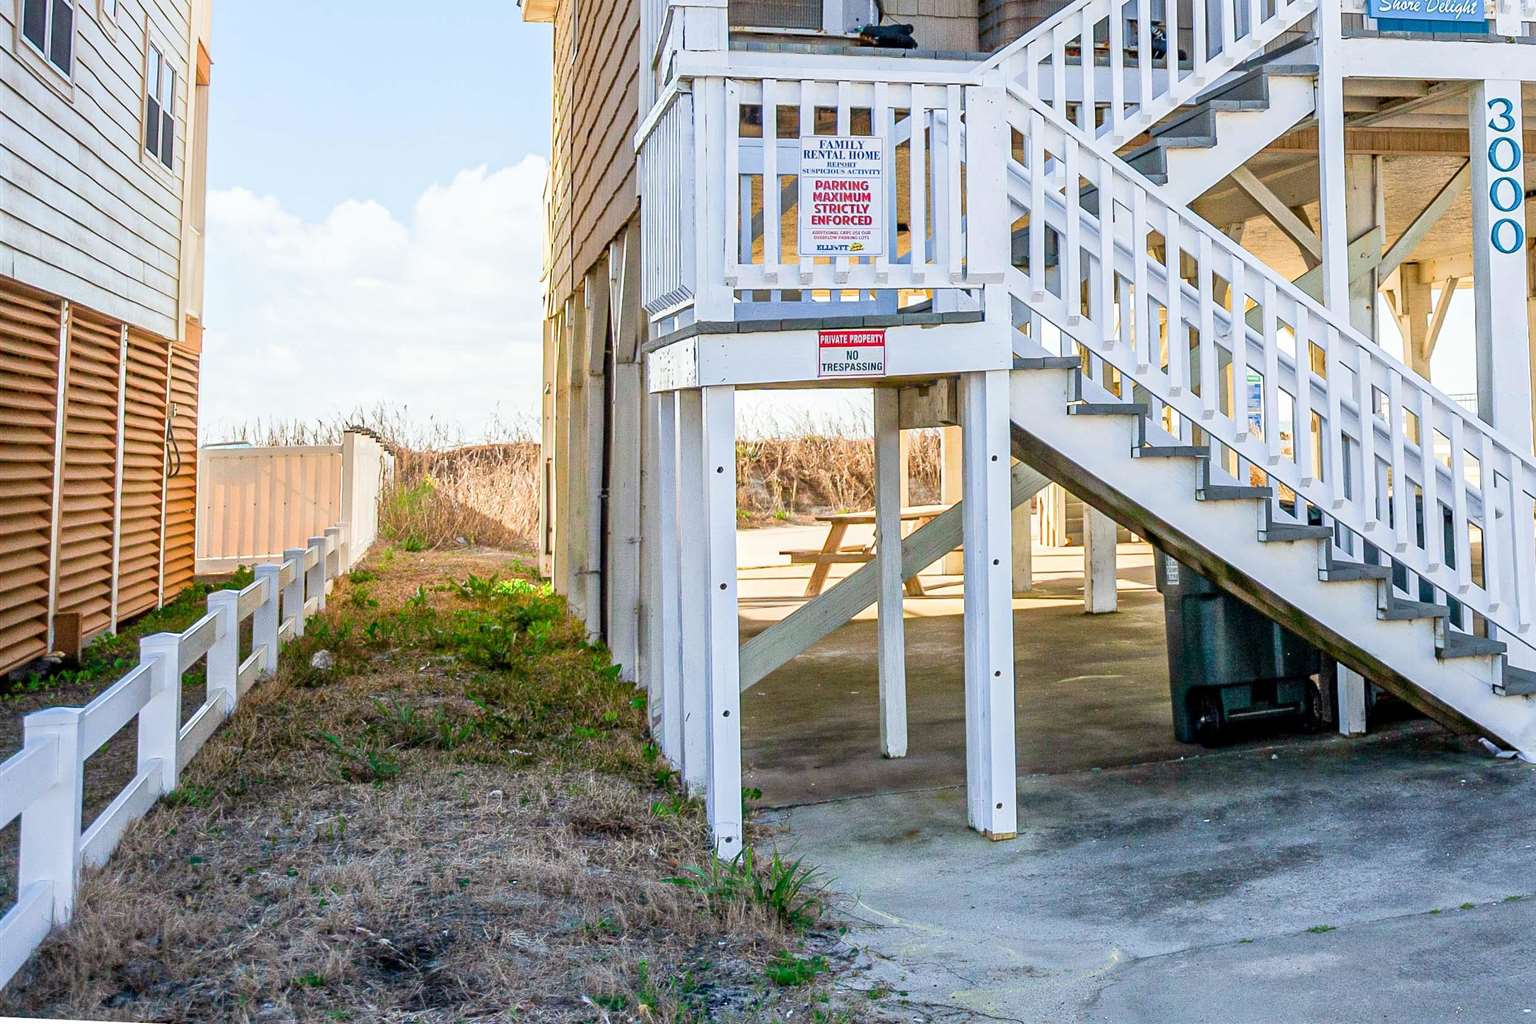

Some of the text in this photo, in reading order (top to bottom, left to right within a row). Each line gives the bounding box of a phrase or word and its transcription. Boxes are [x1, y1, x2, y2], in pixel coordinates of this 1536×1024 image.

[819, 139, 865, 150] FAMILY
[803, 150, 881, 160] RENTAL HOME
[1487, 97, 1524, 255] 3000
[815, 180, 869, 191] PARKING
[813, 192, 871, 202] MAXIMUM
[814, 203, 870, 214] STRICTLY
[811, 215, 872, 226] ENFORCED
[820, 334, 883, 344] PRIVATE PROPERTY
[846, 350, 859, 360] NO
[822, 362, 883, 372] TRESPASSING
